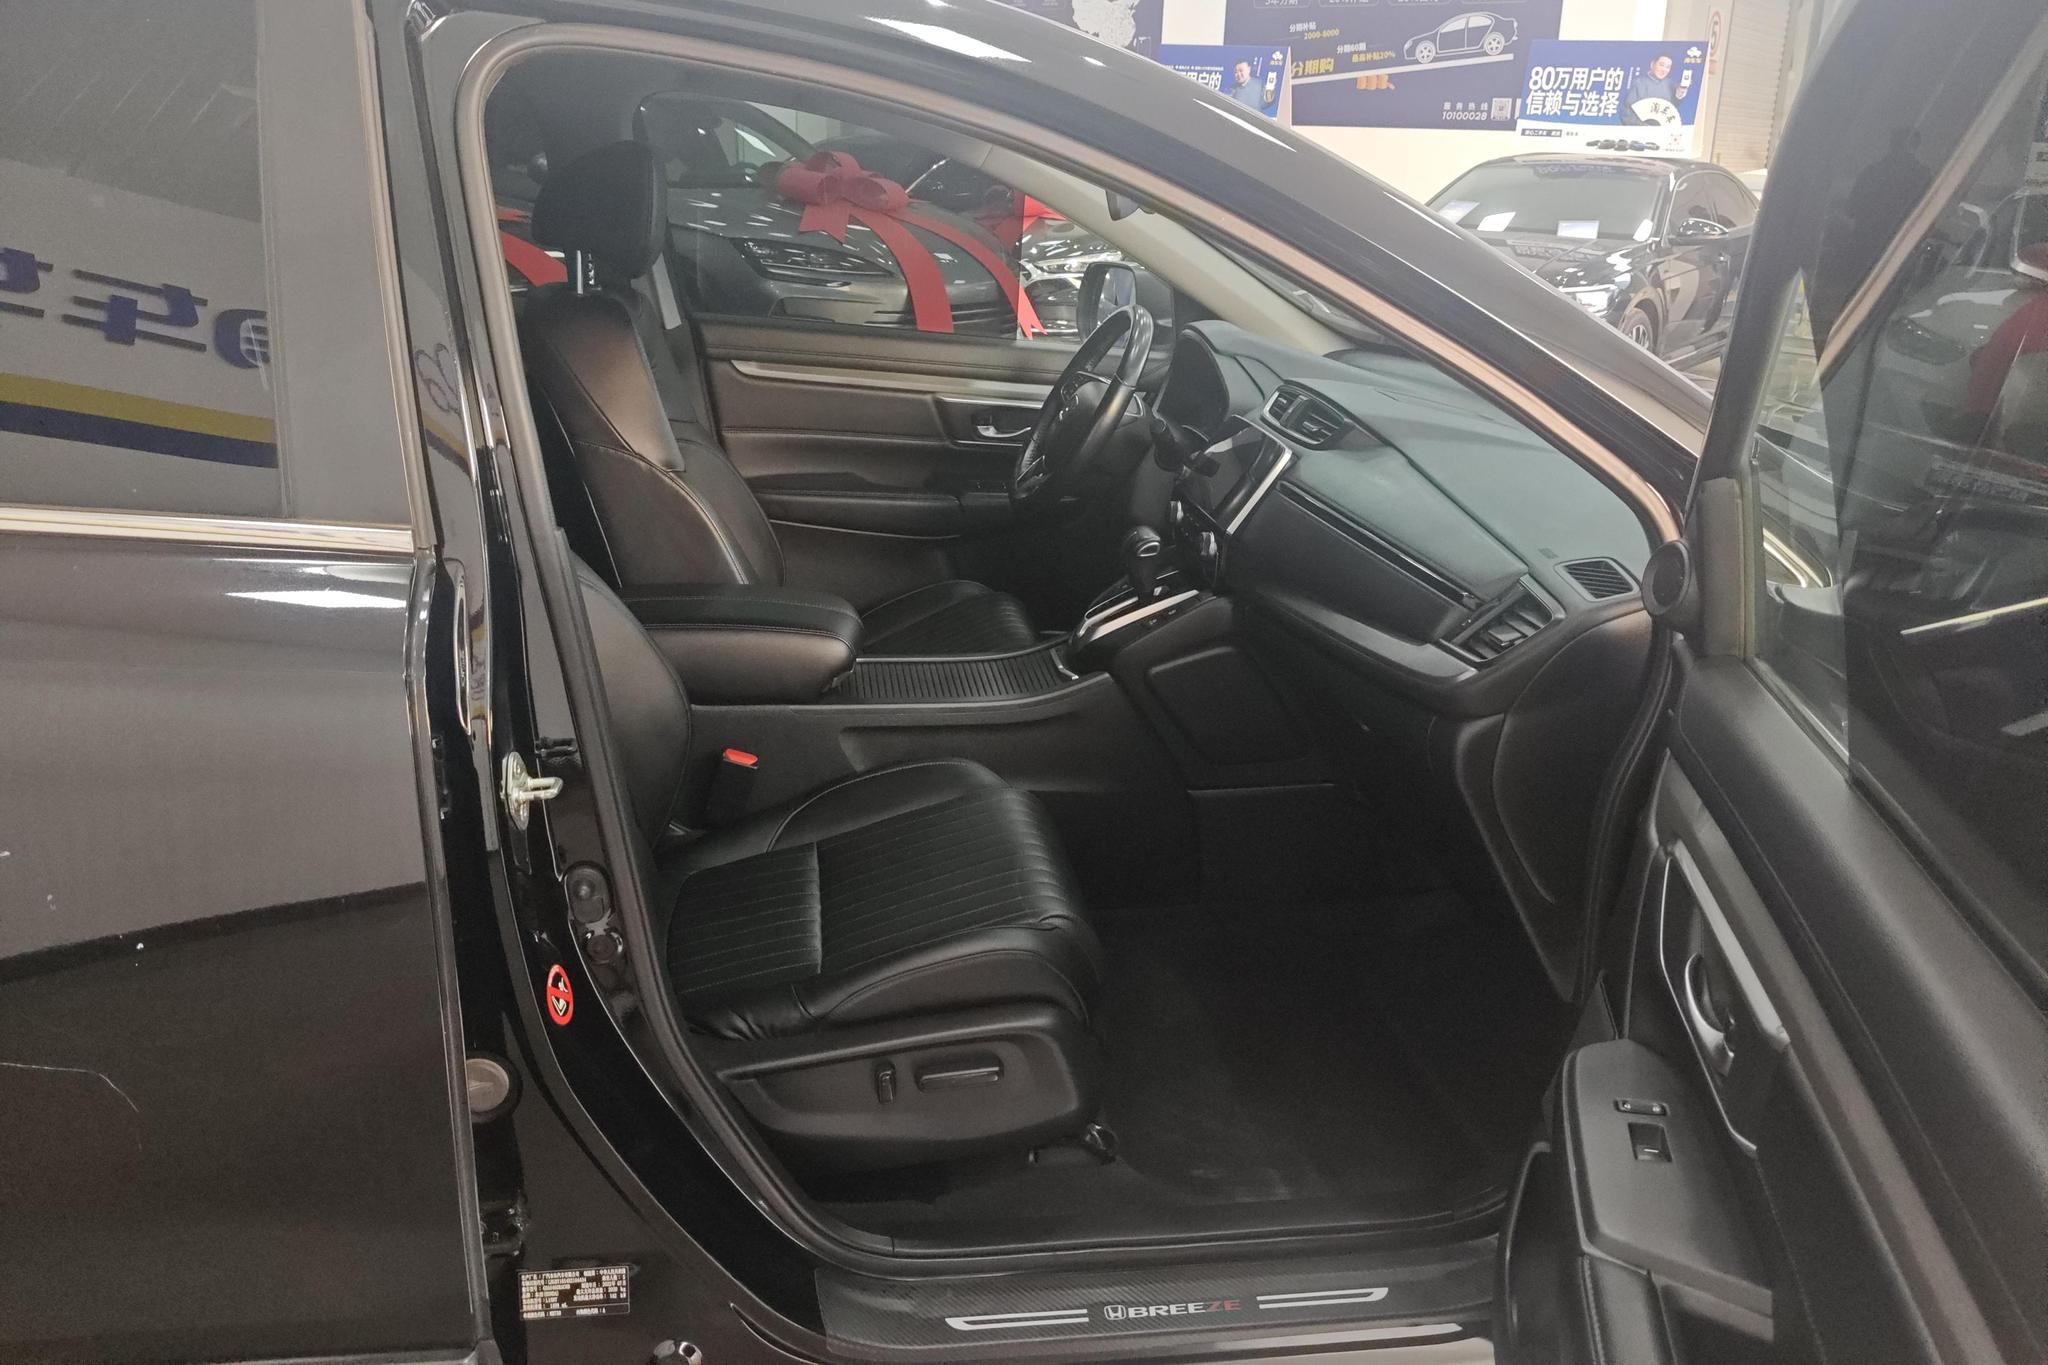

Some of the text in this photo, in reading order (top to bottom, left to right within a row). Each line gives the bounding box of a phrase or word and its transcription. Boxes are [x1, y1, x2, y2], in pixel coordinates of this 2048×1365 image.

[1291, 58, 1334, 76] 分期购
[1528, 66, 1624, 91] 80万用户的
[1525, 91, 1619, 117] 信赖与选择
[1442, 111, 1487, 120] 10100028
[1128, 1300, 1241, 1318] BREEZE
